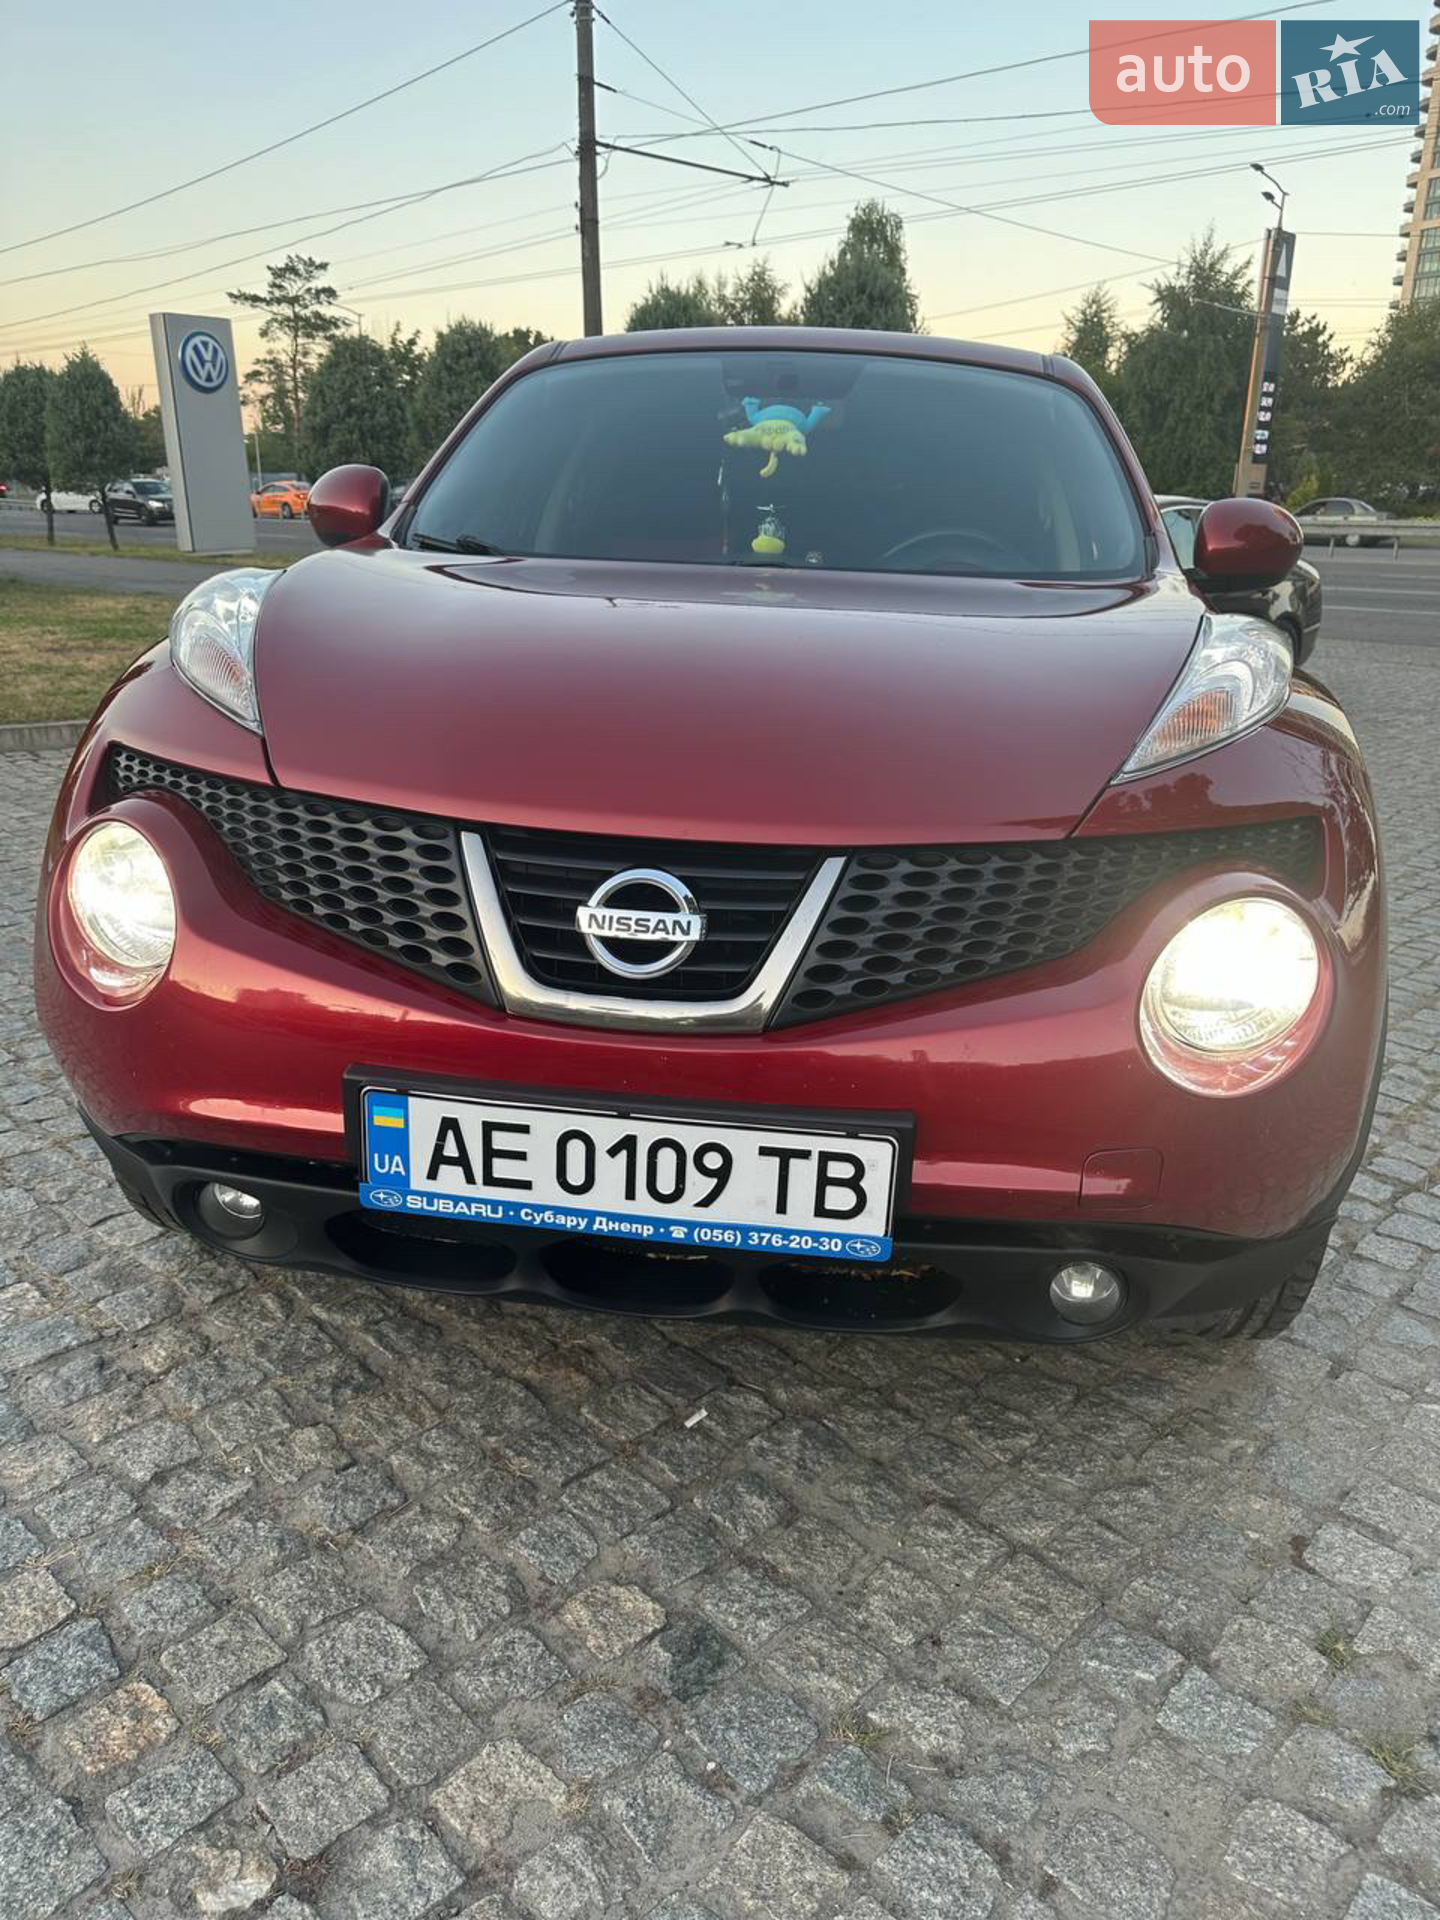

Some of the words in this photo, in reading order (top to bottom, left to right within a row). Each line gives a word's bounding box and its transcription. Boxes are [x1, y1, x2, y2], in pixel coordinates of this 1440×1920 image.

[587, 913, 691, 936] NISSAN
[374, 1153, 405, 1176] UA
[426, 1116, 533, 1190] AE
[556, 1129, 733, 1208] 0109
[758, 1146, 867, 1219] TB
[406, 1195, 503, 1218] SUBARU
[520, 1208, 588, 1230] Субару
[592, 1217, 654, 1236] Днепр
[693, 1226, 742, 1245] (056)
[747, 1232, 841, 1252] 376-20-30
